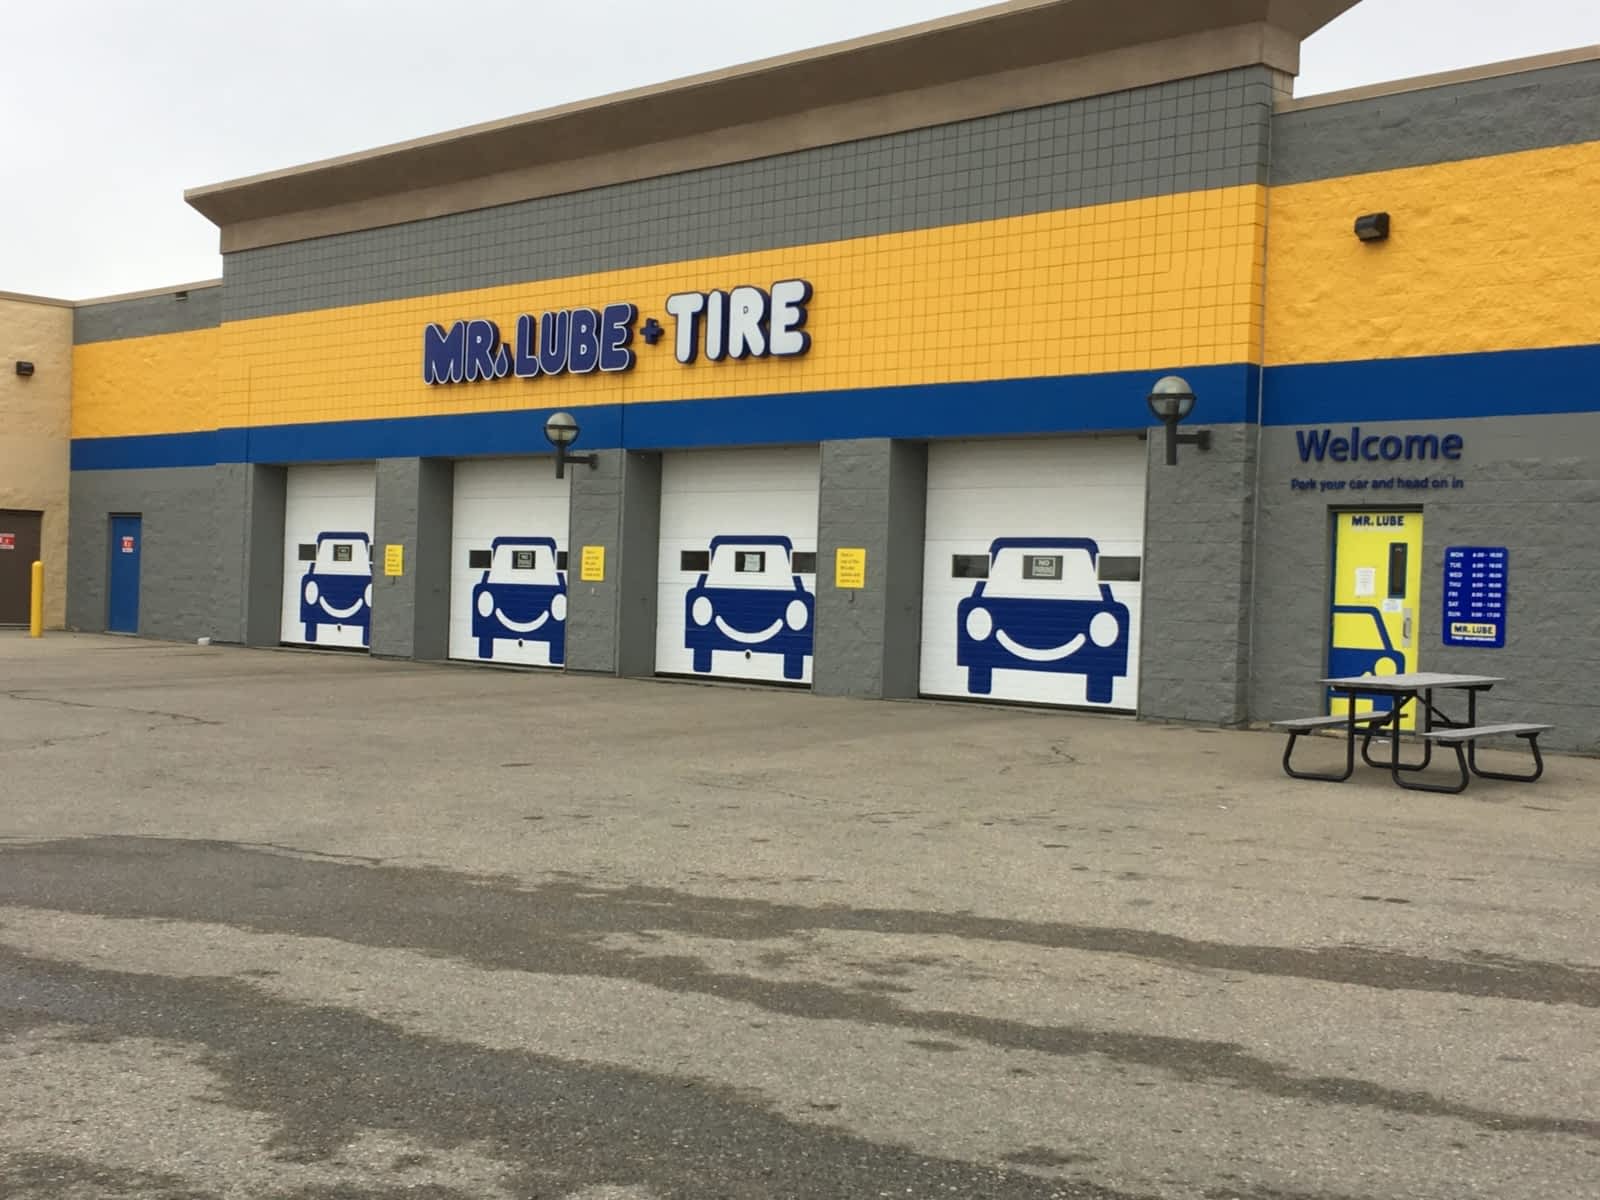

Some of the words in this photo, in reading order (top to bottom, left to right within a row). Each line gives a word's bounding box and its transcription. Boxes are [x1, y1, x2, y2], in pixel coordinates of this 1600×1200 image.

[515, 303, 638, 378] LUBE
[666, 278, 813, 364] TIRE
[1296, 426, 1463, 463] Welcome
[1291, 478, 1316, 490] Park
[1320, 479, 1346, 492] your
[1349, 479, 1369, 490] car
[1371, 477, 1394, 490] and
[1397, 476, 1428, 490] head
[1431, 478, 1447, 489] on
[1452, 476, 1464, 489] in
[1376, 515, 1405, 526] LUBE
[1472, 625, 1493, 635] LUBE
